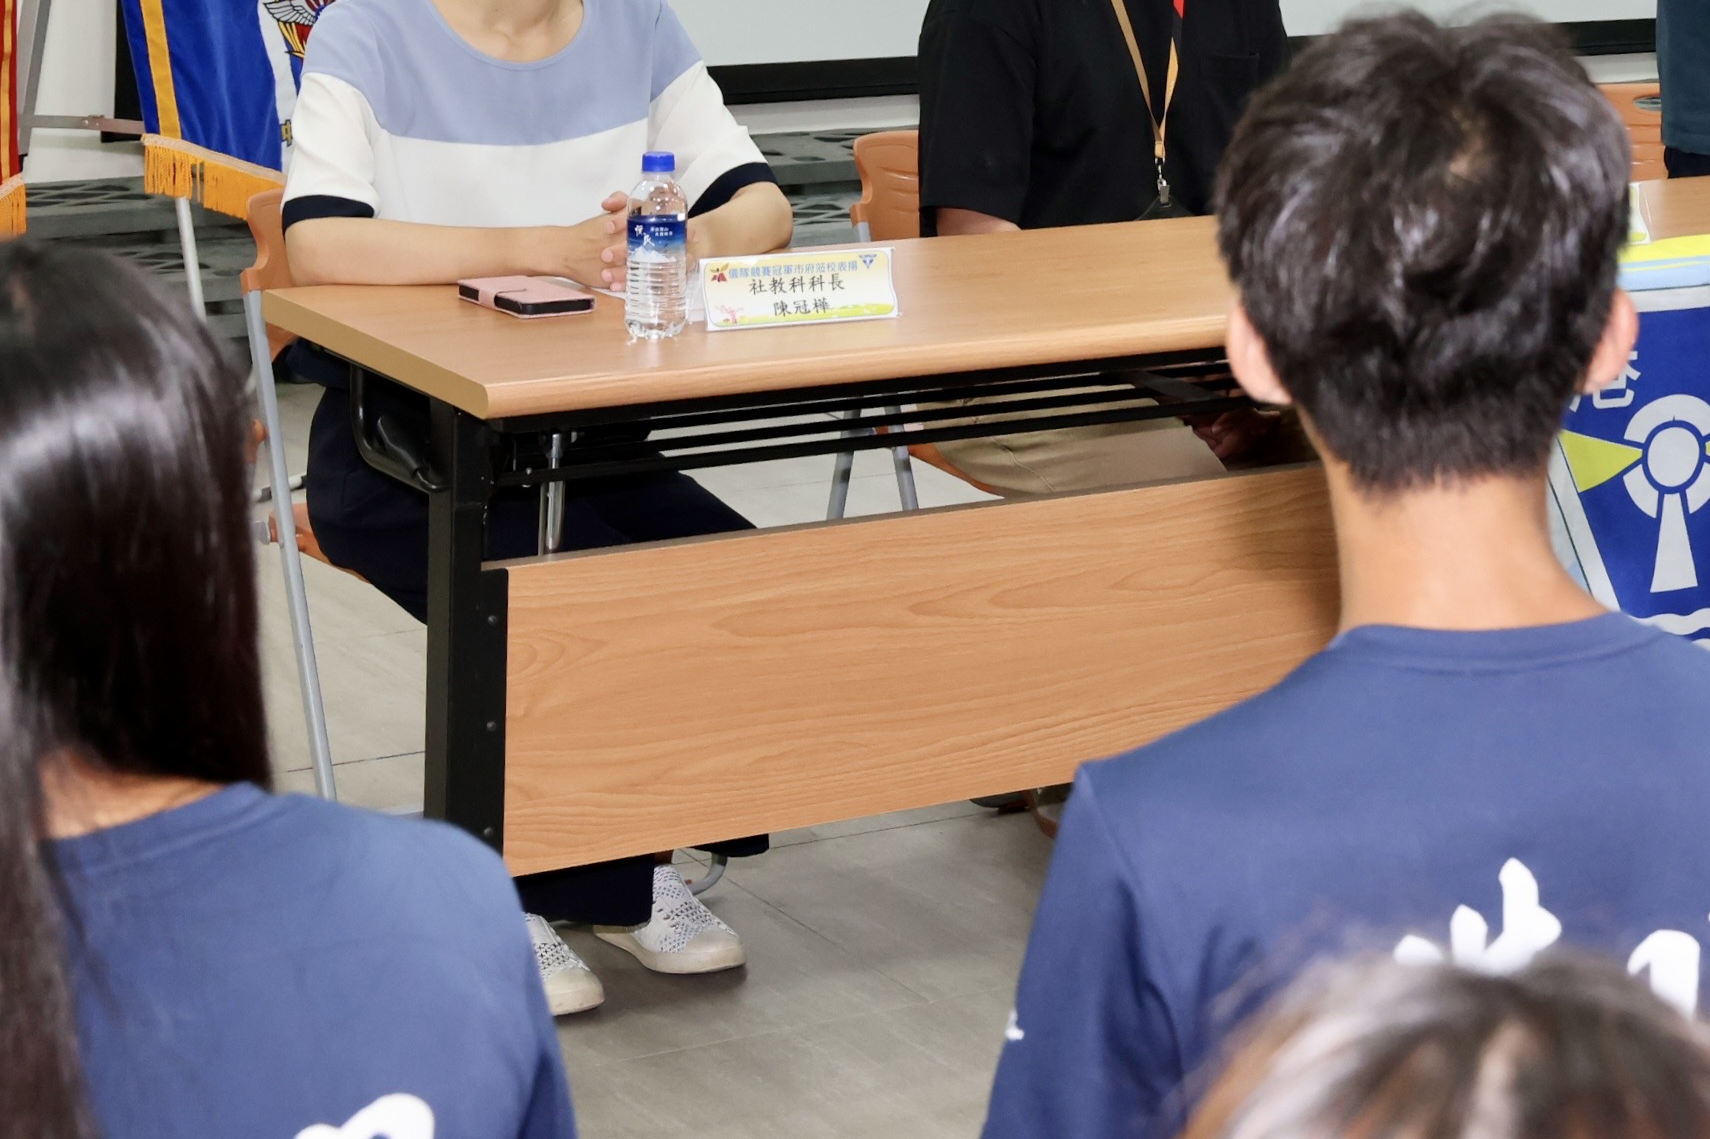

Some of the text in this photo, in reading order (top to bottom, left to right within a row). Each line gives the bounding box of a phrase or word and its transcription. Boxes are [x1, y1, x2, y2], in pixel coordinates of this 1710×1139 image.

[749, 272, 845, 296] 社教科科長
